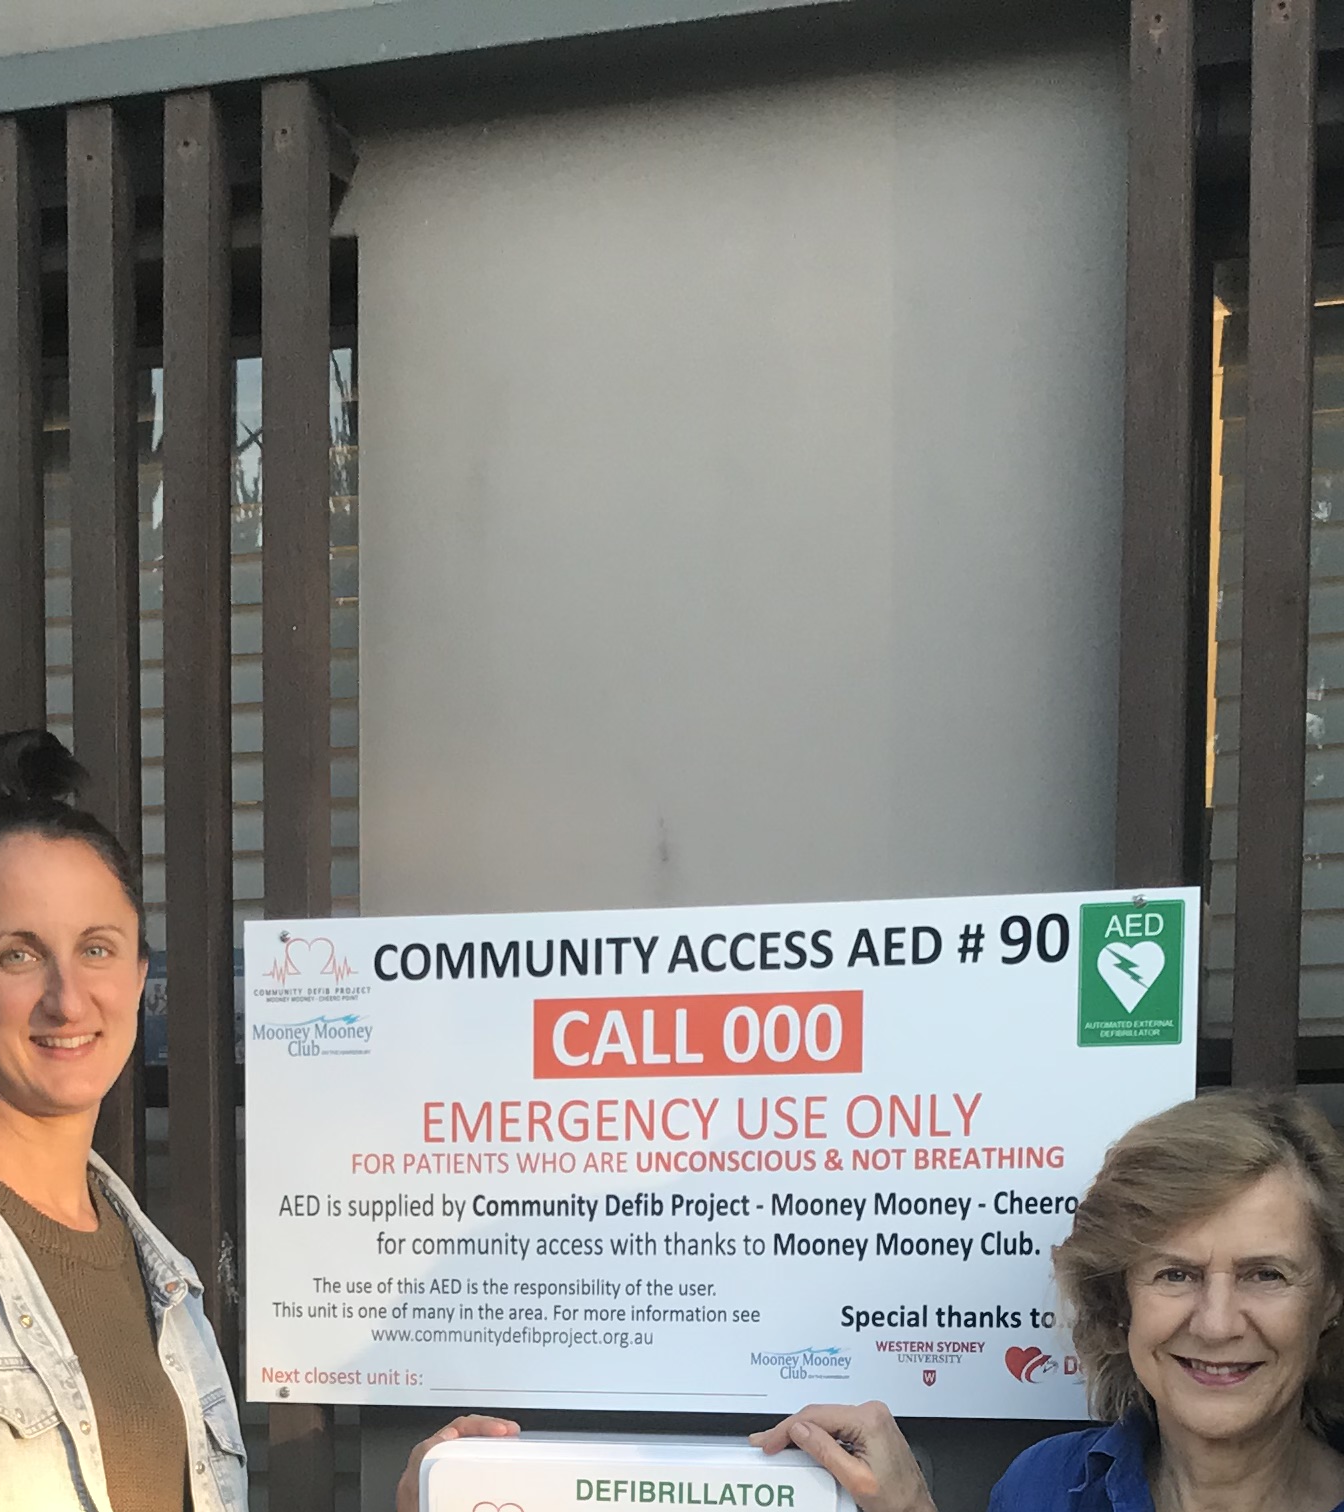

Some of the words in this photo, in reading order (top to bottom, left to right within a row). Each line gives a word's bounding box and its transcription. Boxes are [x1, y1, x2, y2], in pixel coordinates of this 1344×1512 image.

[1104, 913, 1164, 938] AED
[373, 935, 658, 982] COMMUNITY
[667, 930, 833, 974] ACCESS
[847, 926, 943, 968] AED
[958, 923, 985, 964] #
[999, 912, 1071, 965] 90
[253, 988, 303, 997] COMMUNITY
[307, 987, 331, 995] DEFIB
[335, 986, 372, 995] PROJECT
[252, 1024, 311, 1043] Mooney
[314, 1023, 373, 1043] Mooney
[551, 1006, 704, 1068] CALL
[721, 1003, 844, 1065] 000
[287, 1040, 321, 1057] Club
[423, 1098, 720, 1145] EMERGENCY
[736, 1095, 828, 1141] USE
[846, 1092, 984, 1140] ONLY
[351, 1152, 396, 1175] FOR
[402, 1152, 509, 1175] PATIENTS
[515, 1151, 576, 1174] WHO
[582, 1151, 628, 1174] ARE
[635, 1149, 817, 1173] UNCONSCIOUS
[823, 1148, 844, 1172] &
[851, 1147, 907, 1171] NOT
[913, 1144, 1066, 1170] BREATHING
[278, 1195, 321, 1217] AED
[326, 1194, 343, 1217] is
[347, 1193, 435, 1223] supplied
[441, 1193, 467, 1223] by
[471, 1193, 599, 1223] Community
[604, 1193, 664, 1217] Defib
[670, 1193, 751, 1223] Project
[770, 1193, 867, 1223] Mooney
[873, 1192, 972, 1222] Mooney
[993, 1190, 1080, 1216] Cheero
[376, 1232, 406, 1255] for
[411, 1233, 531, 1261] community
[535, 1237, 604, 1256] access
[609, 1232, 657, 1255] with
[663, 1232, 737, 1257] thanks
[742, 1235, 766, 1257] to
[772, 1232, 868, 1261] Mooney
[875, 1232, 974, 1261] Mooney
[980, 1231, 1041, 1257] Club.
[312, 1277, 342, 1295] The
[345, 1281, 373, 1295] use
[376, 1278, 394, 1295] of
[396, 1277, 426, 1295] this
[429, 1278, 463, 1295] AED
[466, 1278, 479, 1295] is
[481, 1278, 509, 1296] the
[513, 1279, 622, 1300] responsibility
[625, 1280, 644, 1297] of
[646, 1280, 673, 1297] the
[678, 1283, 717, 1298] user.
[272, 1302, 304, 1319] This
[307, 1303, 338, 1320] unit
[341, 1303, 354, 1320] is
[357, 1306, 387, 1320] one
[390, 1303, 409, 1320] of
[412, 1307, 455, 1325] many
[459, 1304, 474, 1321] in
[476, 1304, 505, 1321] the
[508, 1307, 547, 1322] area.
[553, 1304, 580, 1322] For
[584, 1308, 626, 1323] more
[630, 1305, 727, 1323] information
[731, 1308, 761, 1323] see
[840, 1305, 928, 1332] Special
[935, 1305, 1022, 1329] thanks
[371, 1326, 654, 1348] www.communitydefibproject.org.au
[875, 1340, 934, 1353] WESTERN
[936, 1341, 986, 1353] SYDNEY
[750, 1352, 800, 1369] Mooney
[802, 1352, 852, 1370] Mooney
[897, 1353, 964, 1365] UNIVERSITY
[260, 1366, 300, 1385] Next
[304, 1368, 362, 1386] closest
[366, 1369, 401, 1386] unit
[405, 1370, 425, 1386] is:
[779, 1366, 807, 1380] Club
[924, 1372, 936, 1383] W
[575, 1478, 796, 1508] DEFIBRILLATOR
